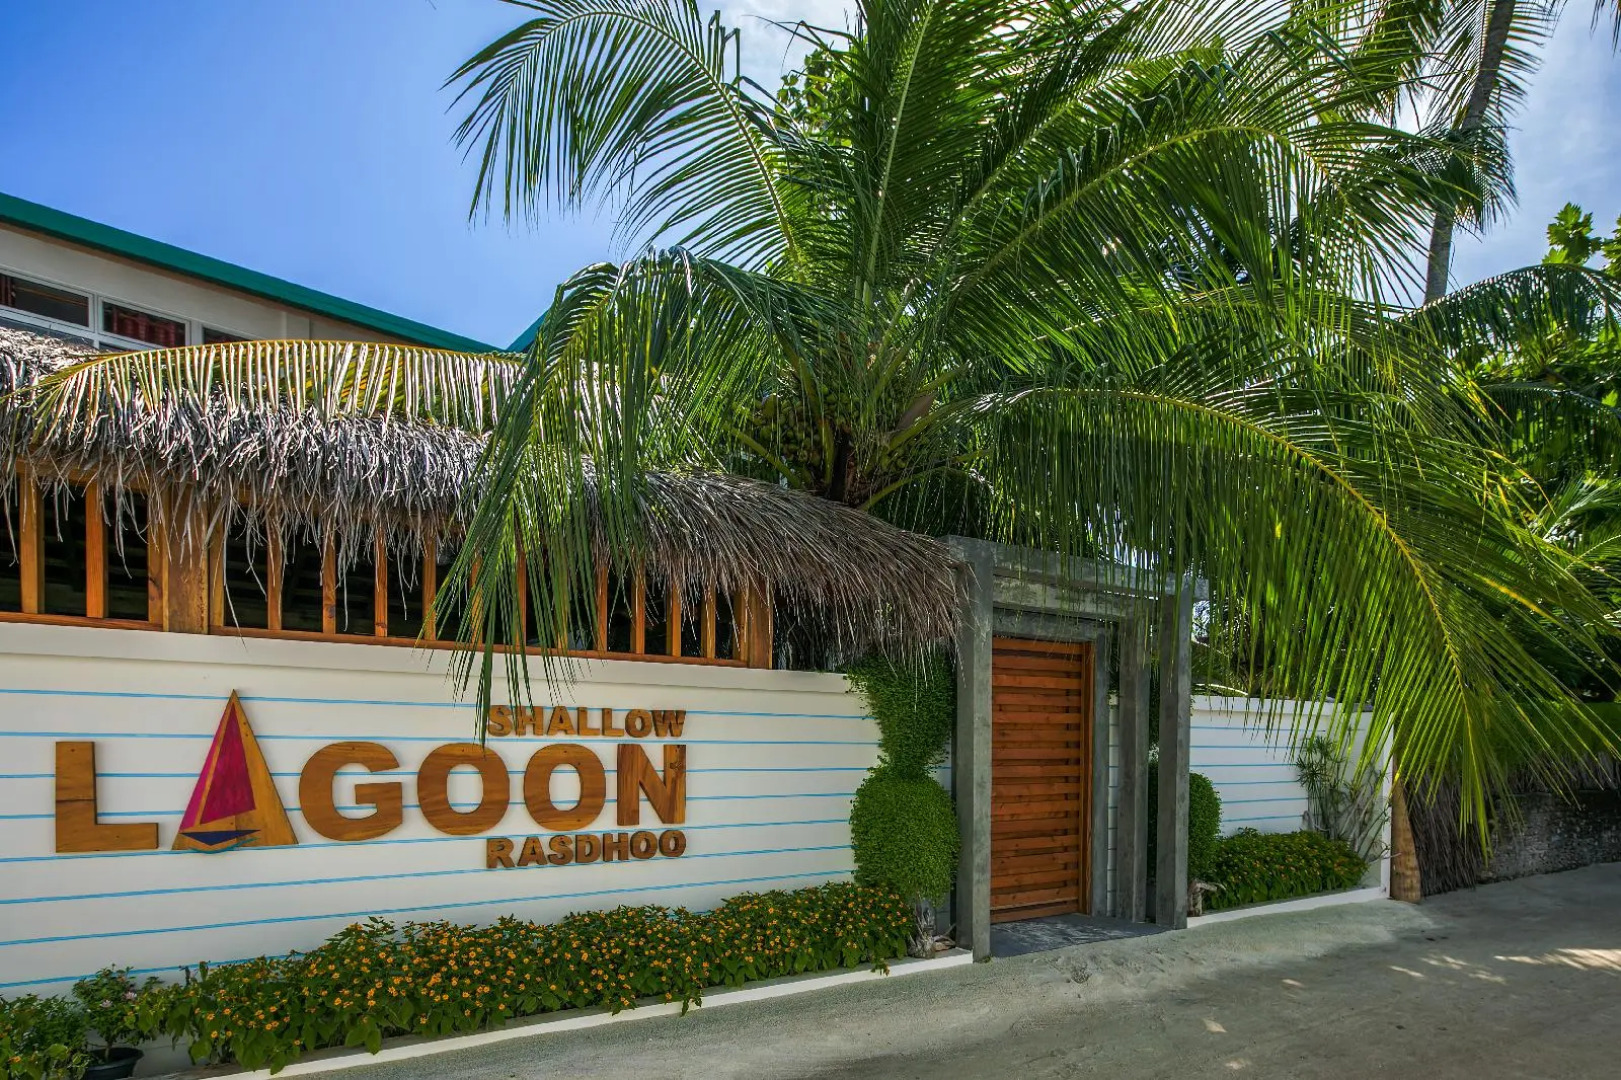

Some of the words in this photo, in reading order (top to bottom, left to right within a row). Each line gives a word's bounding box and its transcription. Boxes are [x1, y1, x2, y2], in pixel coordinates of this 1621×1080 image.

[487, 704, 687, 738] SHALLOW
[55, 689, 687, 855] LAGOON
[486, 829, 687, 869] RASDHOO
